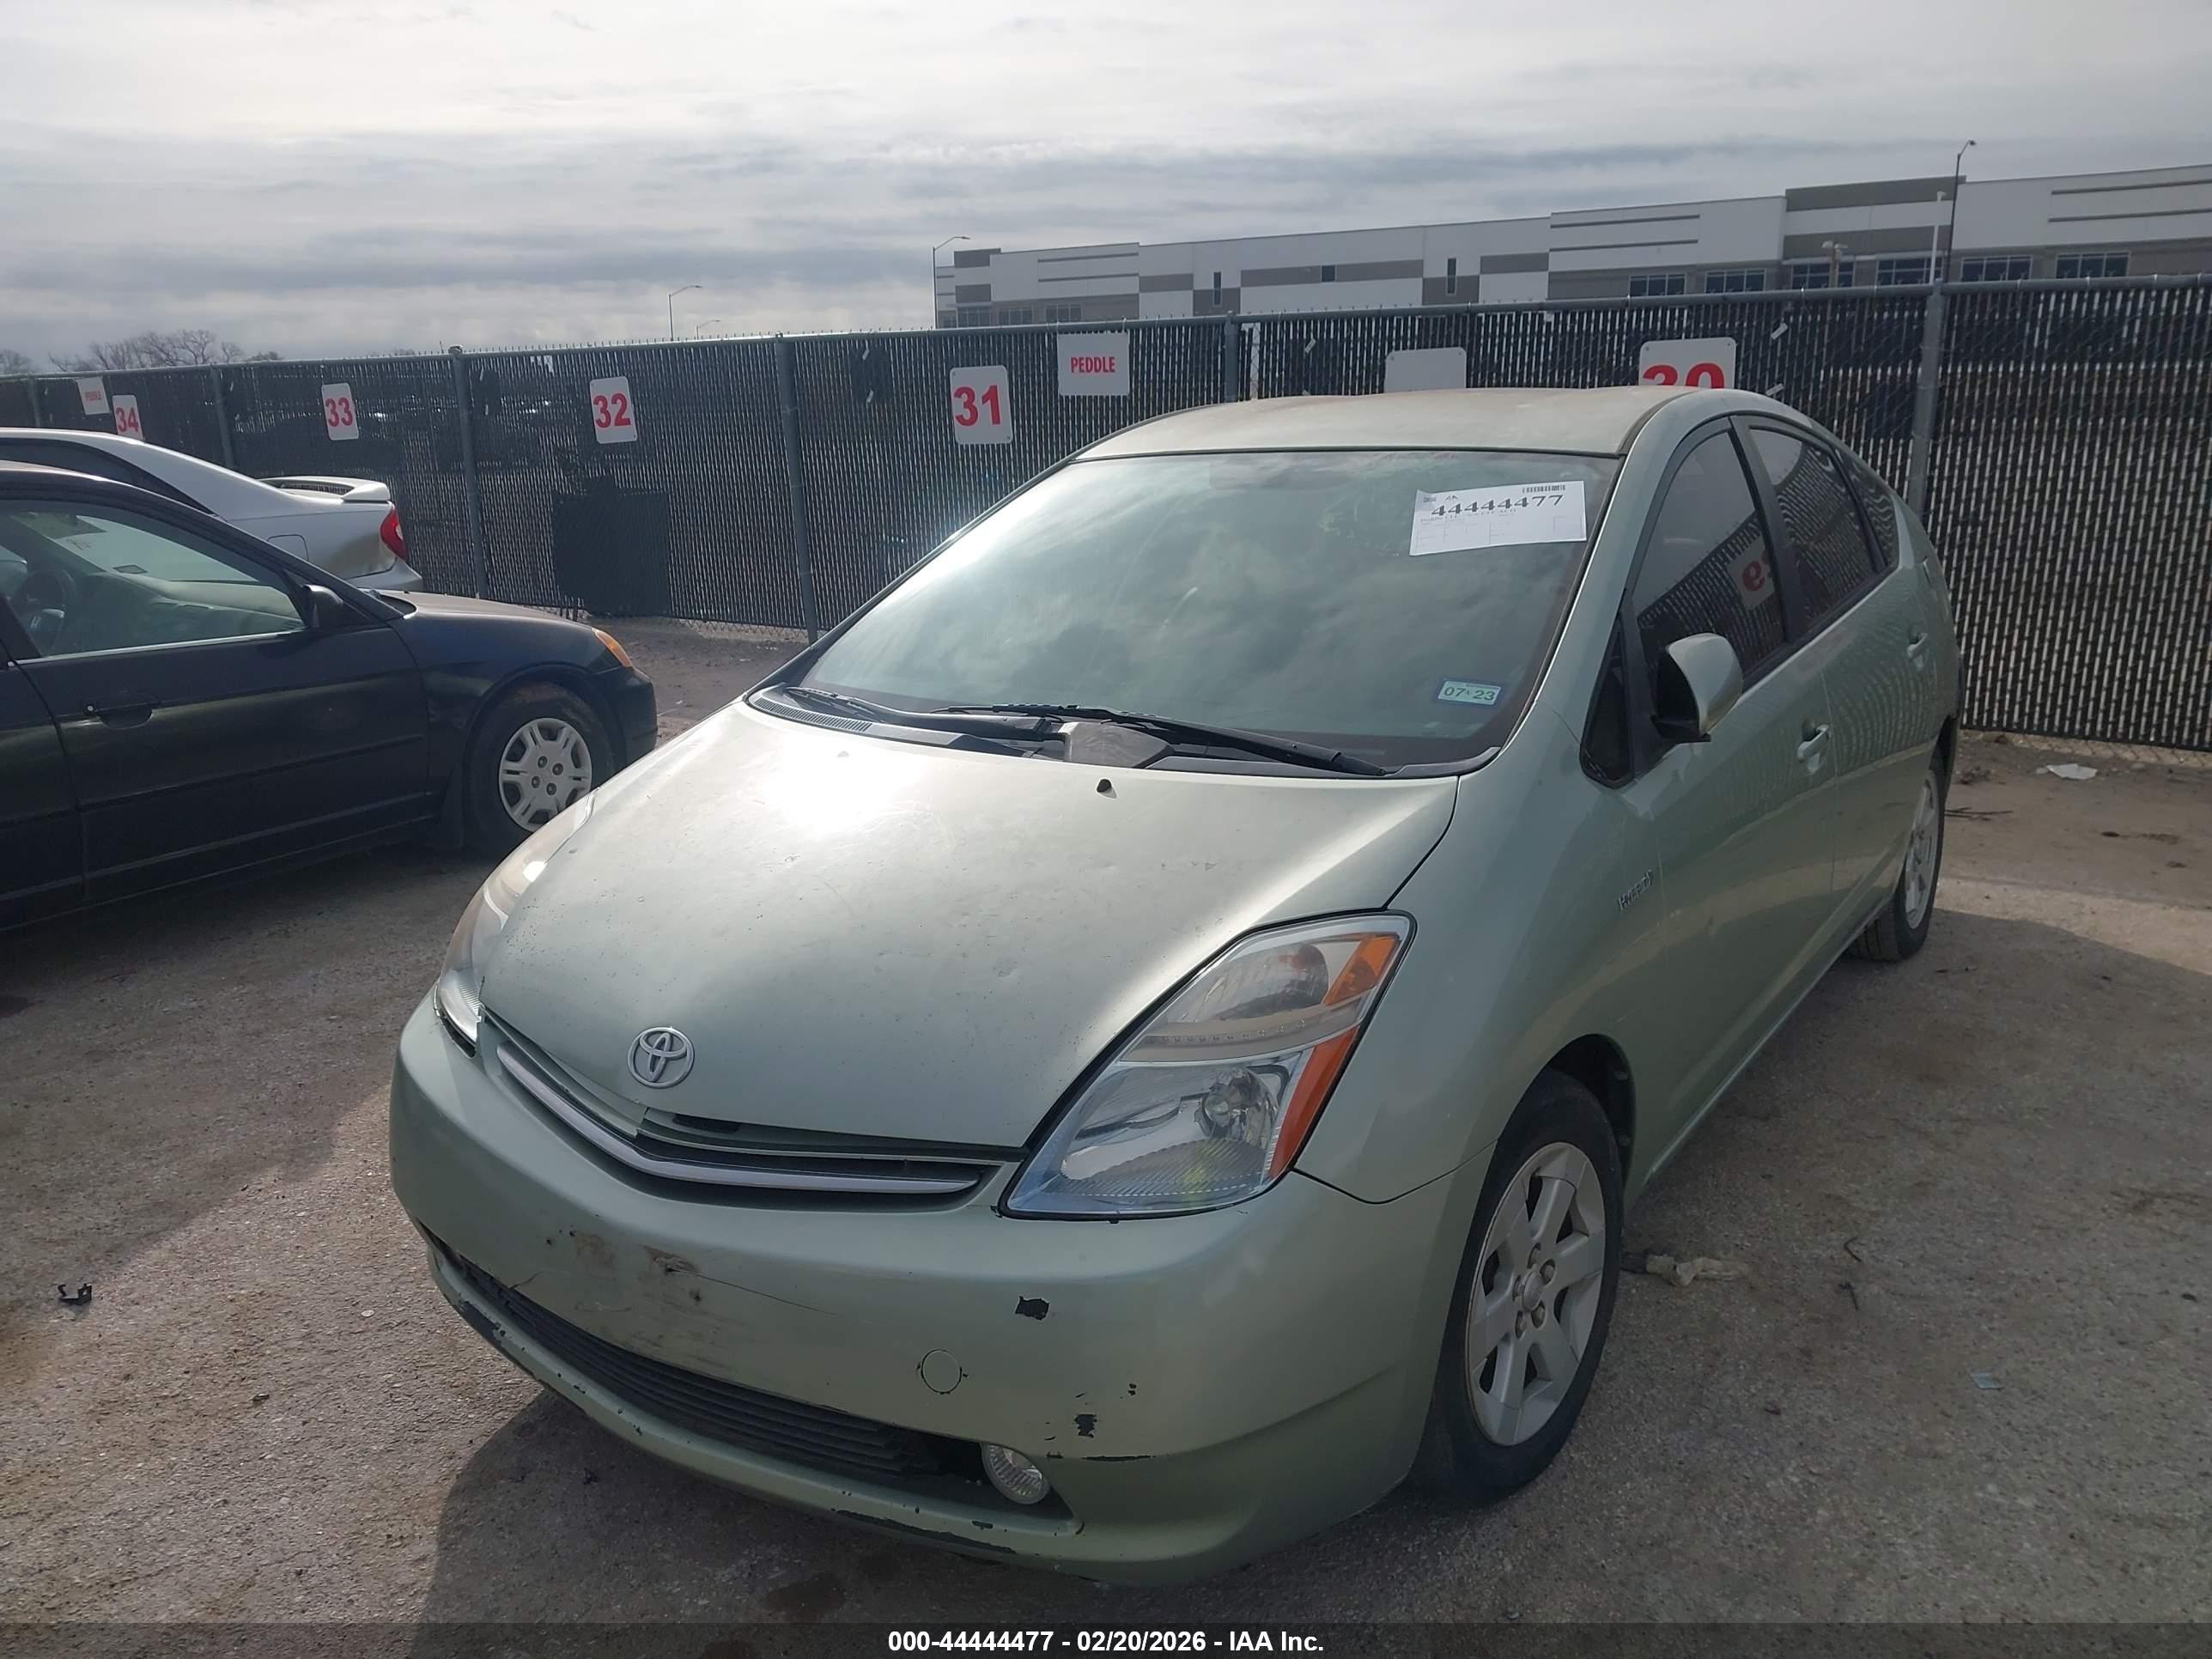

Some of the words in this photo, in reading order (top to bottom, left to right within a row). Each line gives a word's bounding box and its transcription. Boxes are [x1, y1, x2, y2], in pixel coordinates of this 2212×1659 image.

[1071, 356, 1115, 374] PEDDLE
[115, 407, 139, 432] 34
[325, 398, 353, 427] 33
[593, 392, 631, 428] 32
[953, 385, 1001, 427] 31
[1431, 494, 1564, 516] 44444477
